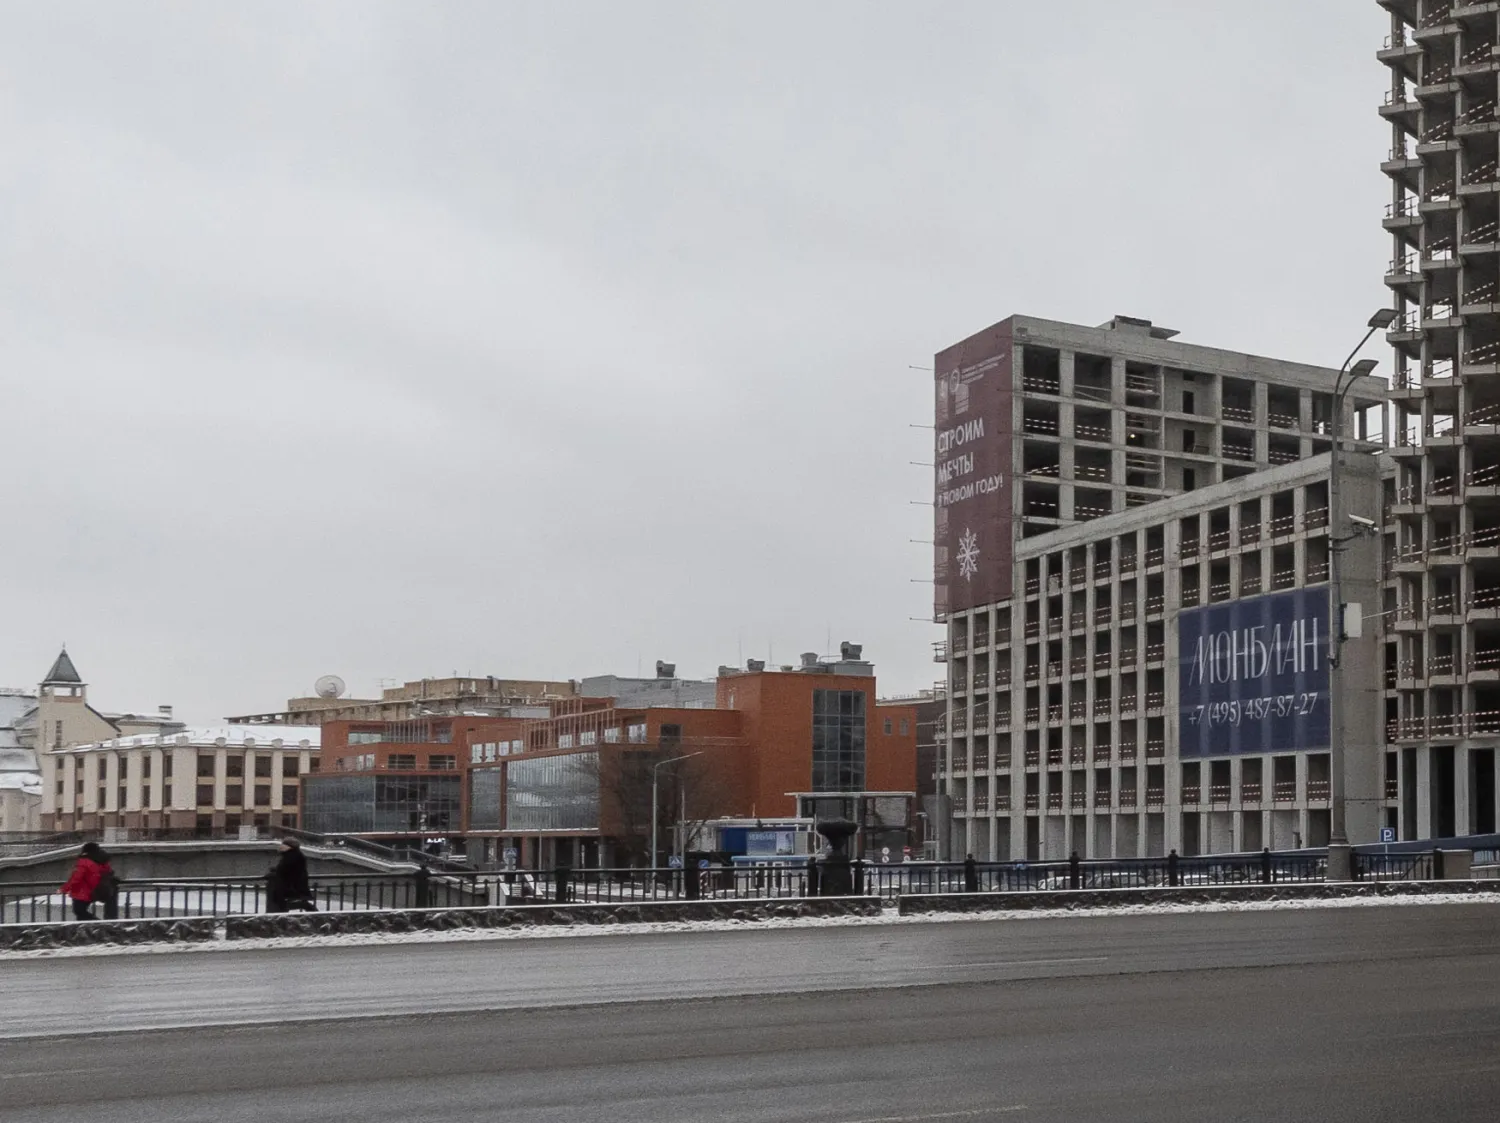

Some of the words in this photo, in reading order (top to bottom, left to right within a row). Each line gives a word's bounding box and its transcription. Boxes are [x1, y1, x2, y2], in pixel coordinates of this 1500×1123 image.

[938, 417, 985, 453] СТРОИМ
[938, 452, 974, 484] МЕЧТЫ
[943, 482, 974, 506] НОВОМ
[976, 472, 1003, 494] ГОДУ!
[1189, 617, 1319, 687] МОНБЛАН
[1188, 704, 1204, 726] +7
[1207, 700, 1242, 728] (495)
[1245, 692, 1318, 719] 487-87-27
